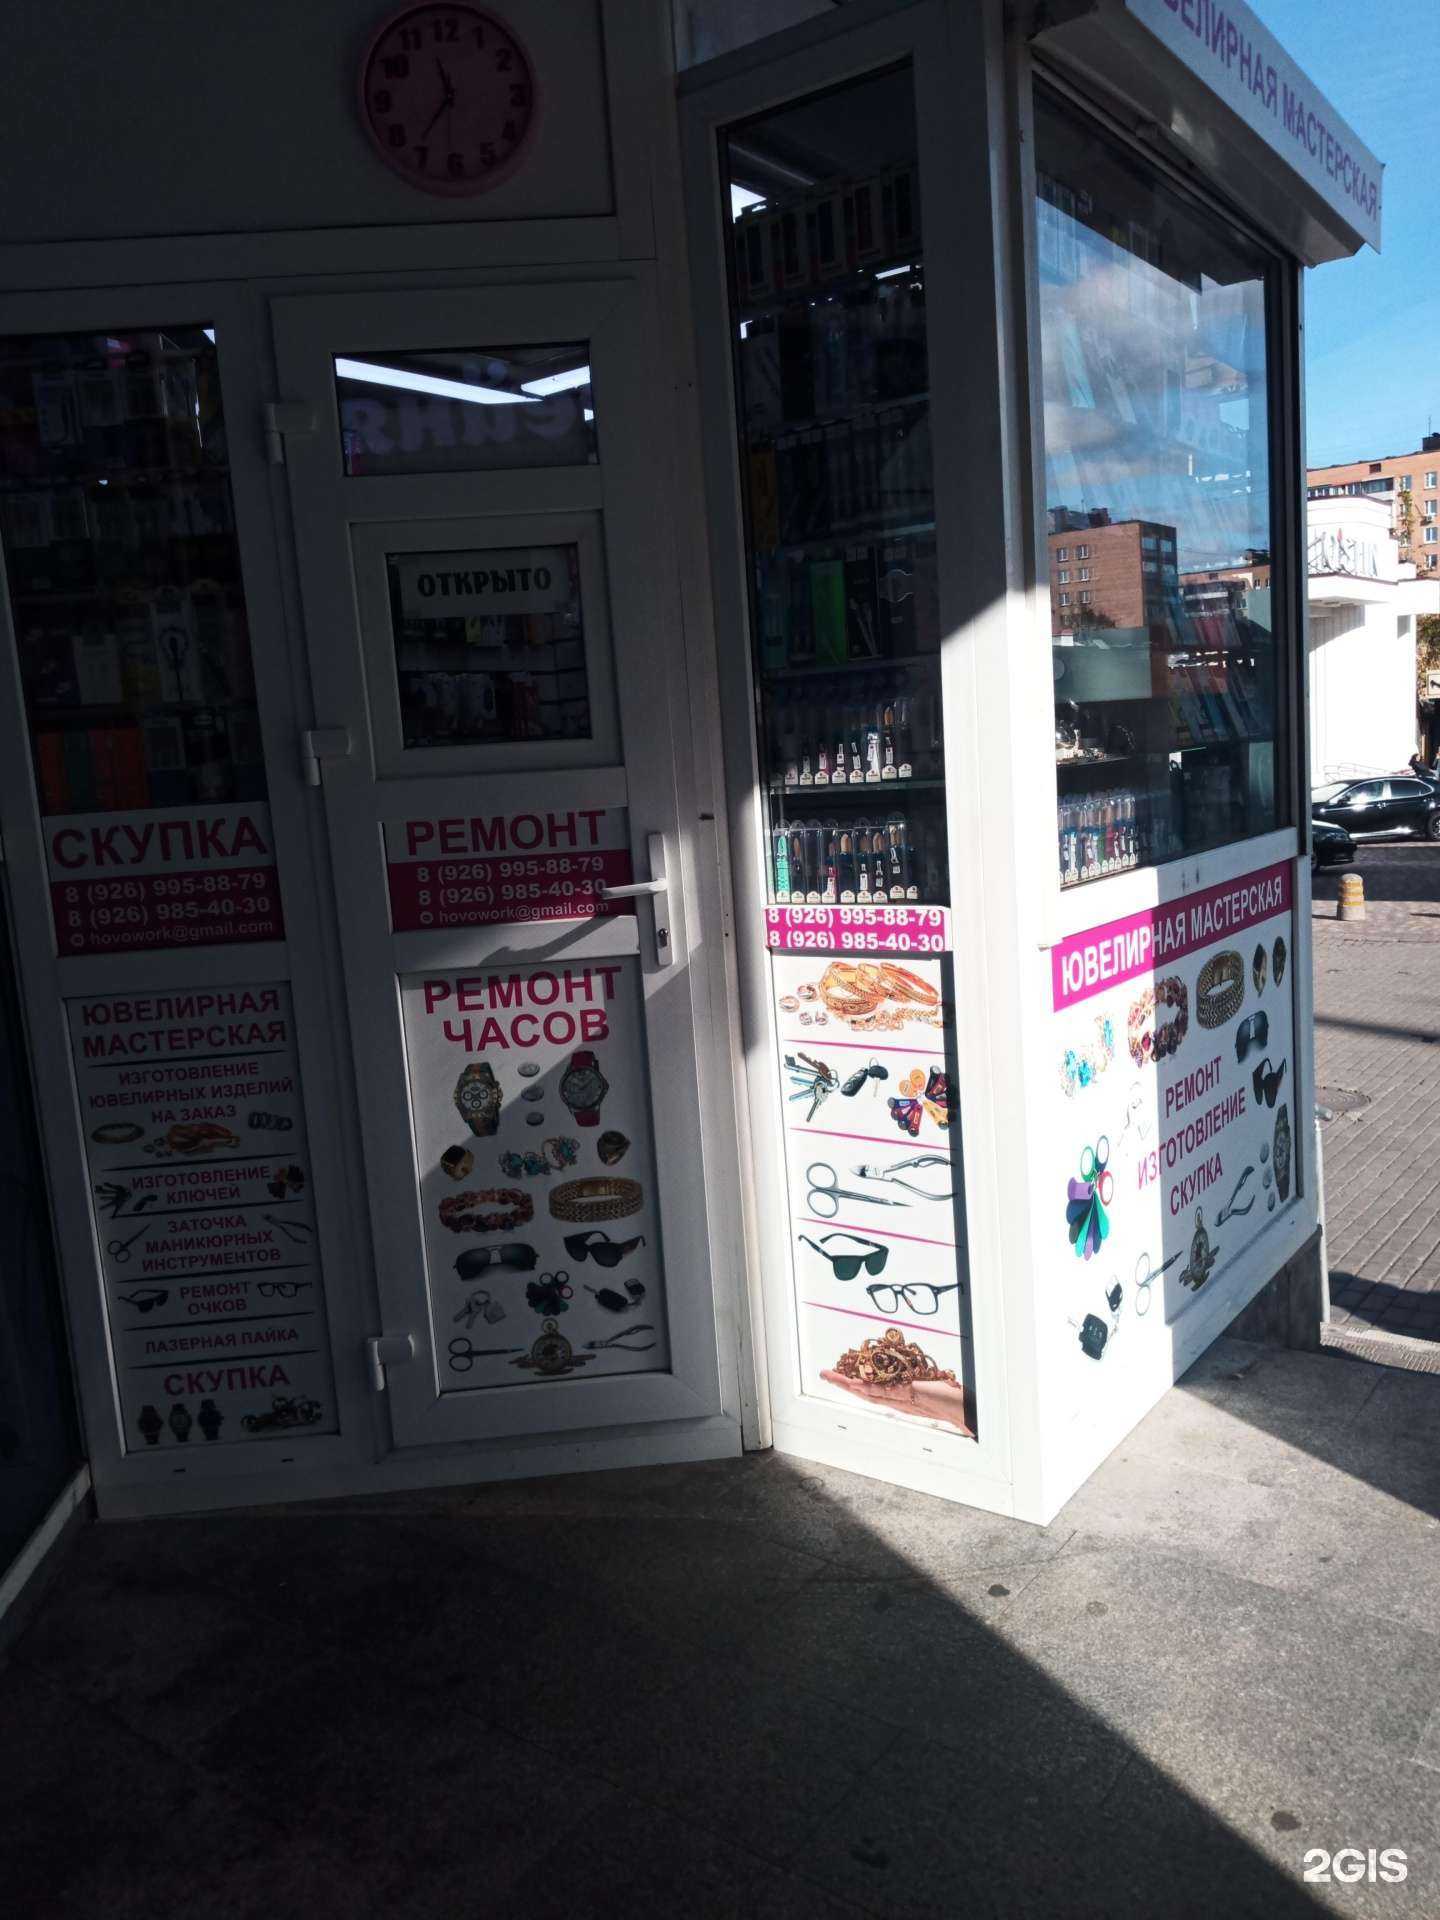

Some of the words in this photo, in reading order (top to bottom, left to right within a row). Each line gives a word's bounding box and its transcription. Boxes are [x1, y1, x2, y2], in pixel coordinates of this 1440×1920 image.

[400, 29, 421, 50] 11
[434, 19, 459, 42] 12
[473, 26, 484, 48] 1
[380, 54, 408, 79] 10
[496, 49, 512, 71] 2
[374, 90, 391, 114] 9
[509, 84, 526, 107] 3
[1163, 0, 1277, 117] ЕЛИРНАЯ
[1282, 82, 1377, 221] МАСТЕРСКАЯ
[389, 124, 406, 147] 8
[502, 120, 515, 142] 4
[414, 147, 428, 168] 7
[447, 153, 464, 177] 6
[480, 142, 497, 167] 5
[418, 567, 551, 597] ОТКРЫТО
[52, 817, 267, 868] СКУПКА
[406, 810, 605, 855] РЕМОНТ
[416, 867, 430, 882] 8
[438, 863, 492, 884] (926)
[500, 856, 604, 877] 995-88-79
[64, 886, 80, 903] 8
[88, 881, 146, 904] (926)
[153, 872, 265, 896] 995-88-79
[419, 889, 431, 905] 8
[440, 886, 494, 907] (926)
[502, 878, 607, 899] 985-40-30
[68, 910, 81, 927] 8
[90, 904, 149, 929] (926)
[157, 896, 270, 919] 985-40-30
[440, 902, 609, 923] hovowork@gmail.com
[768, 908, 779, 924] 8
[785, 908, 834, 928] (926)
[840, 909, 942, 926] 995-88-79
[769, 930, 780, 946] 8
[786, 930, 835, 949] (926)
[841, 932, 943, 951] 985-40-30
[1062, 912, 1186, 996] ЮВЕЛИРНАЯ
[1191, 876, 1282, 941] МАСТЕРСКАЯ
[424, 966, 622, 1014] РЕМОНТ
[82, 990, 280, 1025] ЮВЕЛИРНАЯ
[82, 1021, 287, 1056] МАСТЕРСКАЯ
[443, 1008, 610, 1052] ЧАСОВ
[119, 1062, 259, 1085] ИЗГОТОВЛЕНИЕ
[90, 1087, 205, 1108] ЮВЕЛИРНЫХ
[211, 1077, 293, 1100] ИЗДЕЛИЙ
[1166, 1056, 1222, 1118] РЕМОНТ
[152, 1110, 176, 1123] НА
[181, 1105, 236, 1121] ЗАКАЗ
[1138, 1087, 1245, 1189] ИЗГОТОВЛЕНИЕ
[132, 1167, 270, 1189] ИЗГОТОВЛЕНИЕ
[1170, 1153, 1223, 1215] СКУПКА
[167, 1186, 241, 1204] КЛЮЧЕЙ
[168, 1215, 247, 1233] ЗАТОЧКА
[146, 1231, 273, 1253] МАНИКЮРНЫХ
[142, 1249, 281, 1272] ИНСТРУМЕНТОВ
[180, 1281, 251, 1299] РЕМОНТ
[188, 1299, 247, 1315] ОЧКОВ
[146, 1333, 236, 1353] ЛАЗЕРНАЯ
[241, 1327, 299, 1344] ПАЙКА
[164, 1365, 290, 1395] СКУПКА
